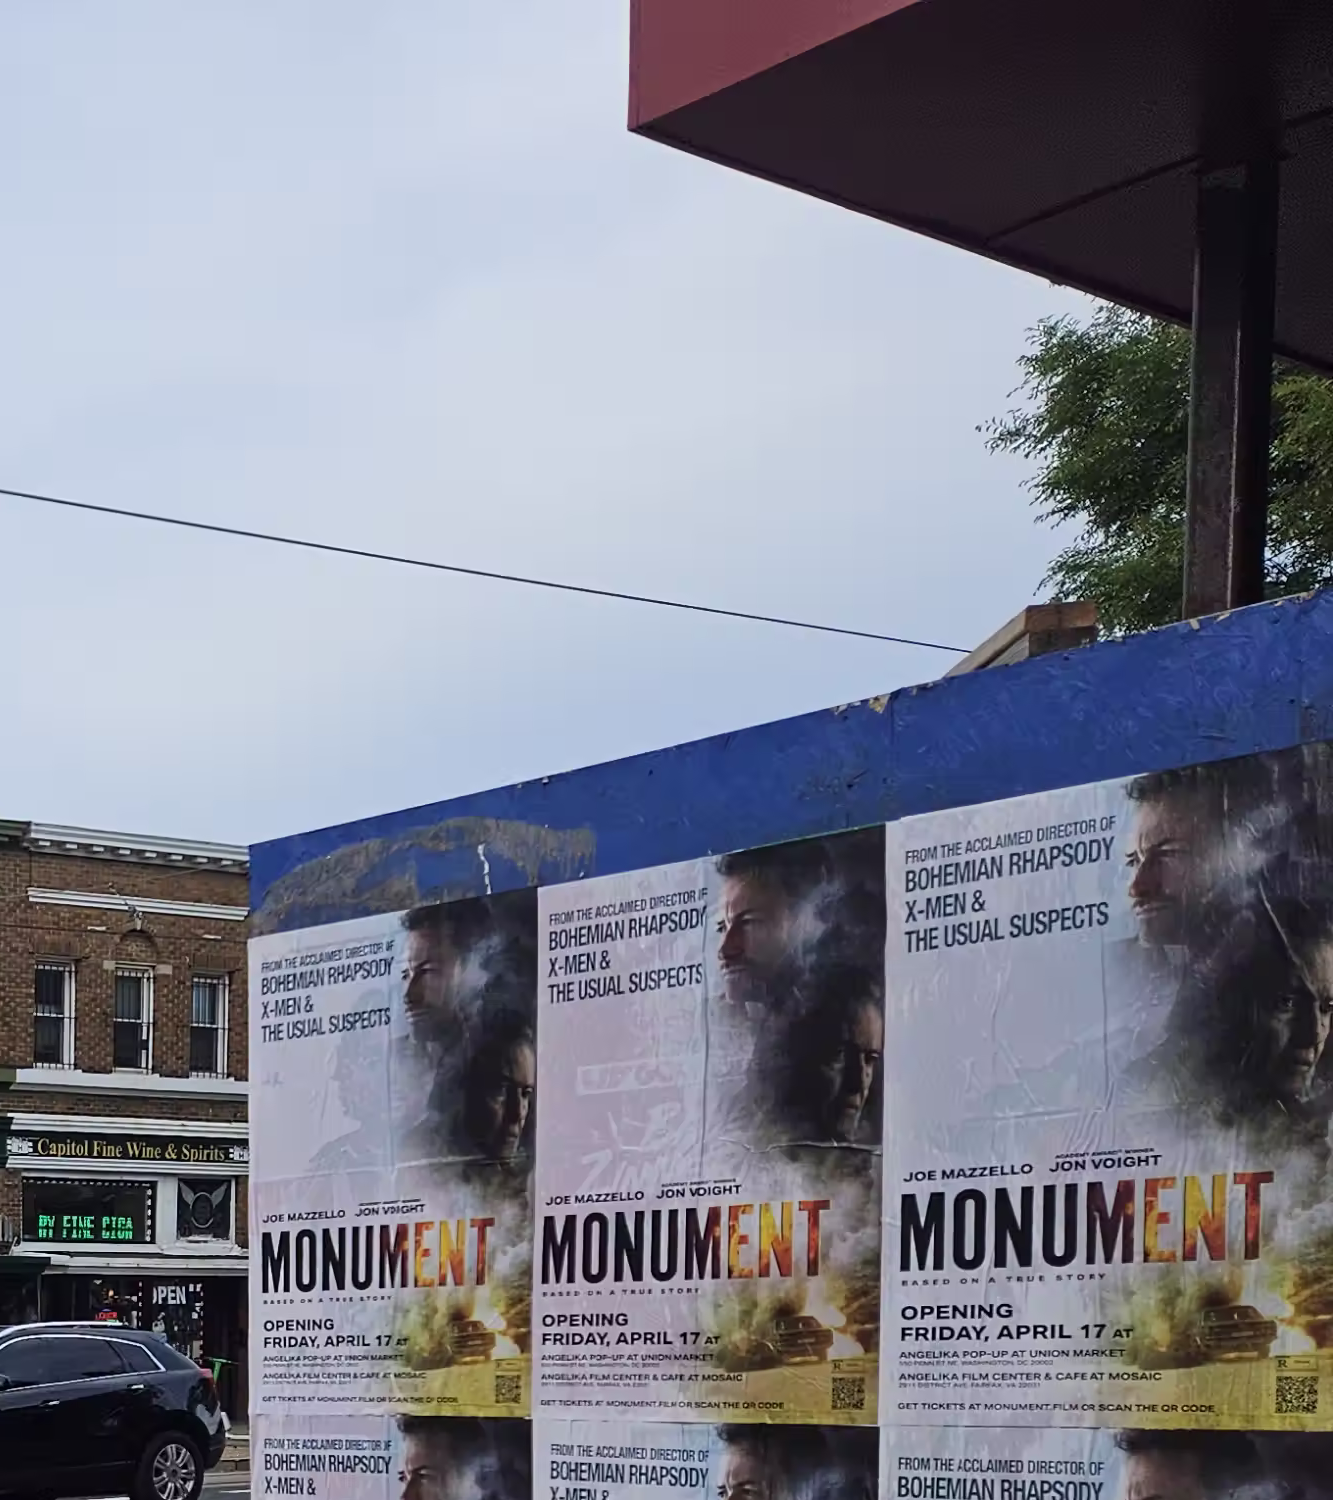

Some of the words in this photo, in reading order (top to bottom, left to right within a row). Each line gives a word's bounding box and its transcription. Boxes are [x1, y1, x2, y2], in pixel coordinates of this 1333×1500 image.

[905, 847, 937, 864] FROM
[941, 842, 962, 858] THE
[965, 830, 1033, 855] ACCLAIMED
[1037, 819, 1096, 842] DIRECTOR
[1100, 816, 1116, 831] OF
[905, 855, 1003, 893] BOHEMIAN
[1009, 836, 1115, 876] RHAPSODY
[905, 892, 966, 923] X-MEN
[972, 890, 986, 912] &
[549, 919, 624, 951] BOHEMIAN
[628, 905, 707, 939] RHAPSODY
[905, 927, 939, 953] THE
[944, 917, 1004, 948] USUAL
[1010, 902, 1109, 938] SUSPECTS
[261, 967, 324, 995] BOHEMIAN
[328, 956, 395, 989] RHAPSODY
[37, 1137, 88, 1158] Capitol
[94, 1139, 122, 1157] Fine
[126, 1142, 161, 1158] Wine
[165, 1145, 177, 1160] &
[181, 1144, 225, 1162] Spirits
[904, 1171, 940, 1183] JOE
[942, 1164, 1033, 1180] MAZZELLO
[1049, 1160, 1086, 1172] JON
[1091, 1154, 1162, 1170] VOIGHT
[900, 1171, 1274, 1272] MONUMENT
[541, 1199, 830, 1285] MONUMENT
[262, 1217, 495, 1294] MONUMENT
[901, 1304, 1013, 1320] OPENING
[542, 1332, 611, 1347] FRIDAY,
[616, 1331, 673, 1345] APRIL
[679, 1331, 701, 1345] 17
[704, 1336, 721, 1345] AT
[901, 1326, 989, 1342] FRIDAY,
[997, 1325, 1072, 1339] APRIL
[1081, 1324, 1106, 1338] 17
[1112, 1329, 1134, 1338] AT
[1099, 1404, 1132, 1412] SCAN
[264, 1454, 326, 1472] BOHEMIAN
[329, 1455, 392, 1474] RHAPSODY
[551, 1461, 624, 1484] BOHEMIAN
[629, 1465, 709, 1488] RHAPSODY
[898, 1457, 930, 1471] FROM
[934, 1459, 954, 1471] THE
[957, 1459, 1023, 1474] ACCLAIMED
[1028, 1460, 1085, 1475] DIRECTOR
[1089, 1462, 1105, 1475] OF
[898, 1477, 994, 1500] BOHEMIAN
